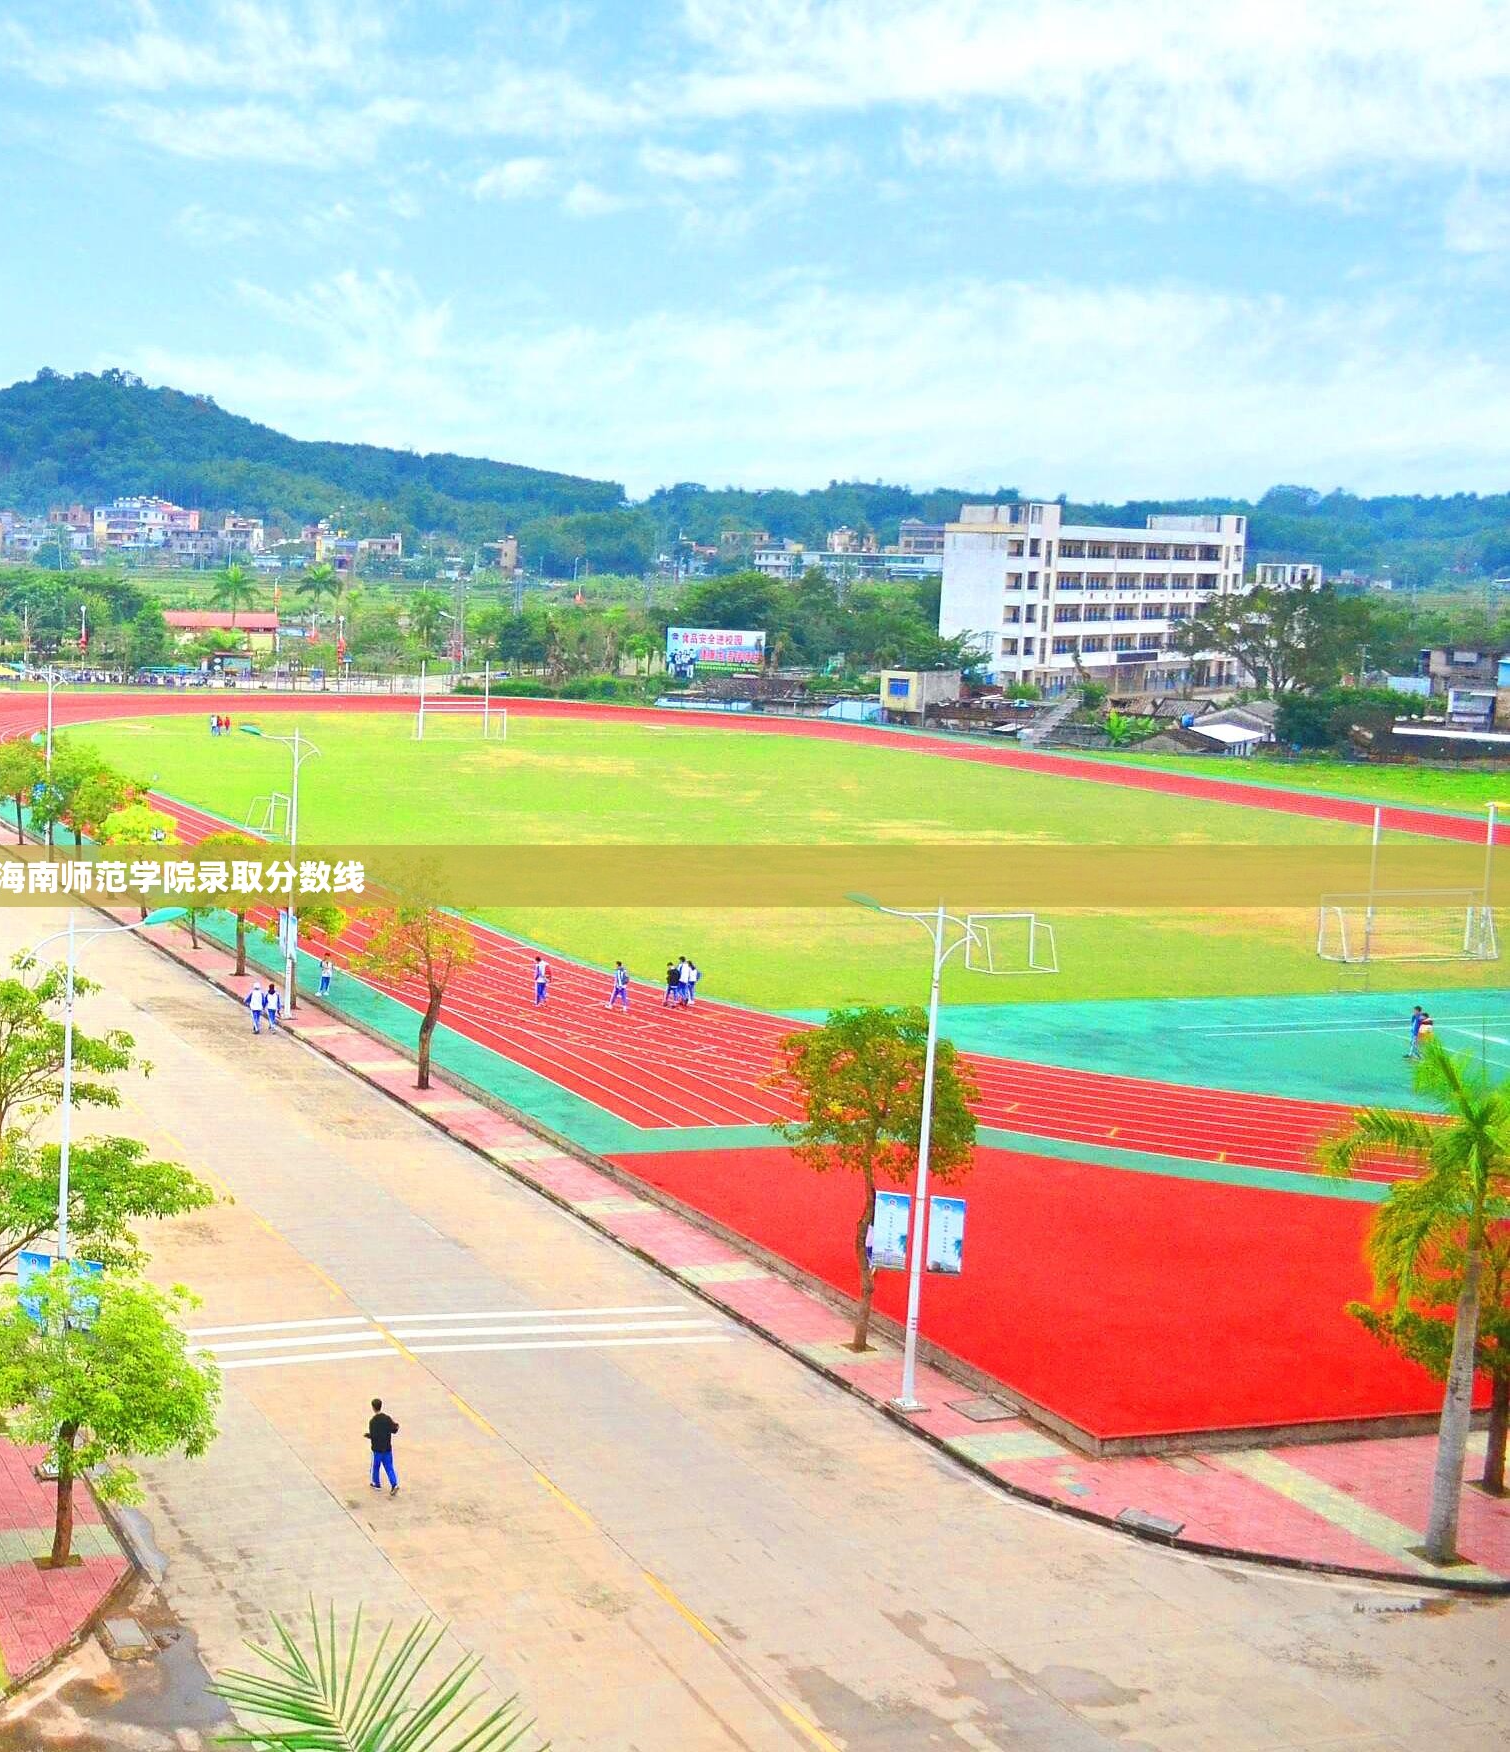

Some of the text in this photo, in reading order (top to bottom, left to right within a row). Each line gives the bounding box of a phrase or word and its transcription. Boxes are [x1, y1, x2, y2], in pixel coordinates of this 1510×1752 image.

[682, 632, 743, 646] 食品安全进校园
